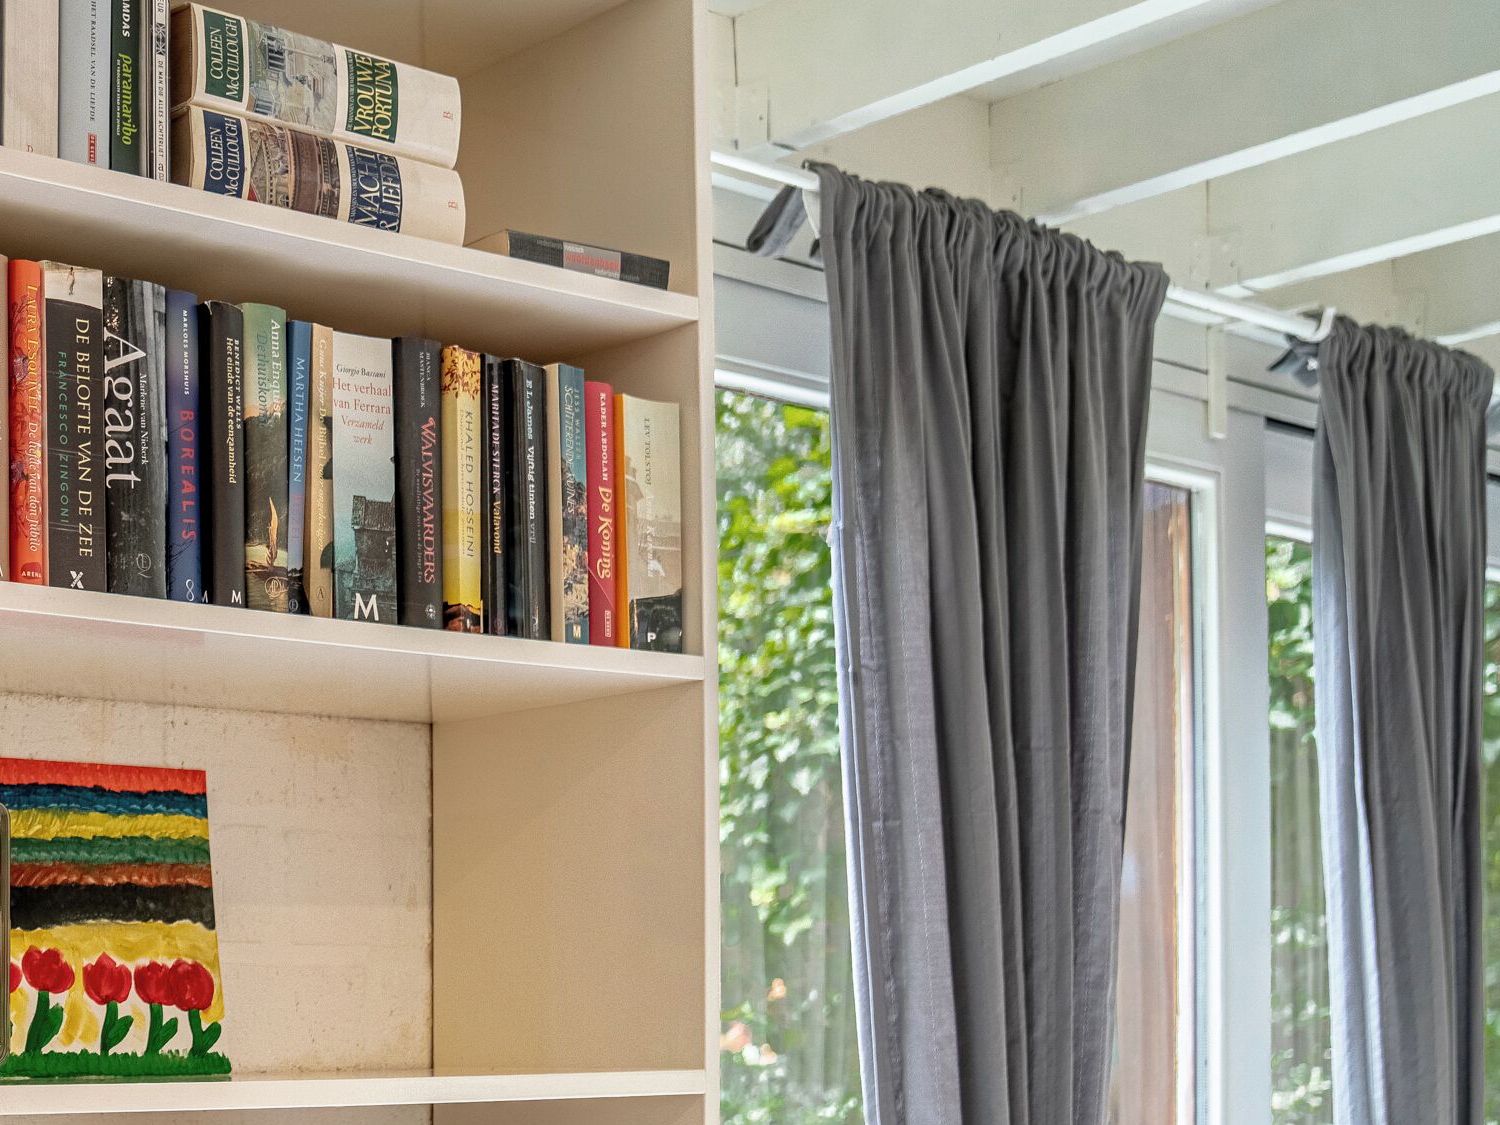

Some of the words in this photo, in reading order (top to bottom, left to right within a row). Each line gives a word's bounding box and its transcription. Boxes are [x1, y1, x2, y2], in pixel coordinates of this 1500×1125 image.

[210, 26, 222, 80] COLLEEN
[225, 18, 238, 99] McCULLOUGH
[118, 53, 138, 145] paramaribo
[353, 55, 372, 132] VROUWE
[372, 61, 391, 140] FORTUNA
[210, 127, 222, 180] COLLEEN
[380, 155, 398, 213] LIEFDE
[354, 147, 379, 228] MACHT
[27, 284, 38, 332] LAURA
[76, 318, 90, 345] DE
[27, 339, 39, 413] ESQUIVEL
[58, 352, 68, 444] FRANCESCO
[76, 352, 91, 434] BELOFTE
[295, 357, 305, 423] MARTHA
[333, 378, 351, 391] Het
[353, 383, 391, 396] verhaal
[334, 399, 349, 409] van
[354, 399, 391, 415] Ferrara
[104, 327, 147, 489] Agaat
[341, 415, 385, 431] Verzameld
[77, 442, 91, 482] VAN
[227, 419, 236, 483] eenzaamheid
[294, 427, 303, 482] HEESEN
[465, 411, 474, 472] KHALED
[59, 455, 68, 523] ZINGONI
[78, 491, 92, 516] DE
[180, 409, 196, 540] BOREALIS
[421, 417, 436, 583] WALVISVAARDERS
[79, 523, 93, 557] ZEE
[465, 482, 474, 557] HOSSEINI
[596, 516, 612, 579] Koning
[354, 592, 379, 621] M
